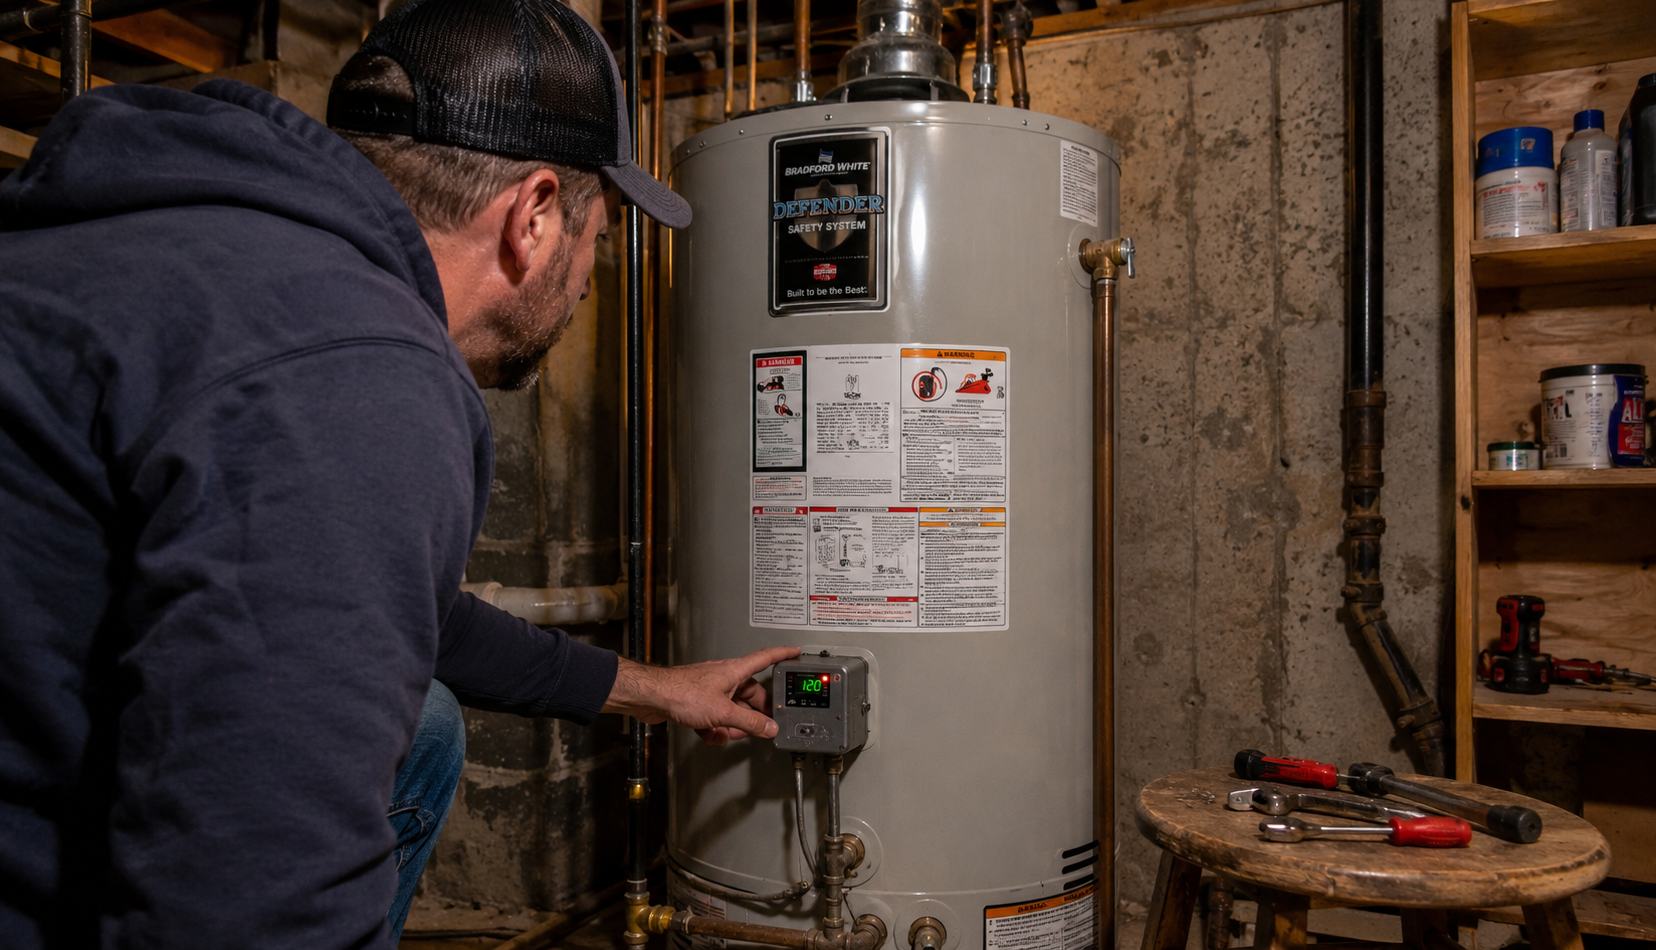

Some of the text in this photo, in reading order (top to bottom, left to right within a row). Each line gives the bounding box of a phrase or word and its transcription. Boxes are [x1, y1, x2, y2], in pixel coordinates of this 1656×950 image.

[785, 164, 835, 176] BRADFORD
[837, 162, 869, 171] WHITE
[774, 196, 883, 219] DEFENDER
[788, 221, 866, 234] SAFETY SYSTEM
[787, 289, 805, 297] Built
[806, 288, 815, 296] to
[816, 287, 828, 295] be
[829, 286, 843, 295] the
[802, 679, 821, 692] 120
